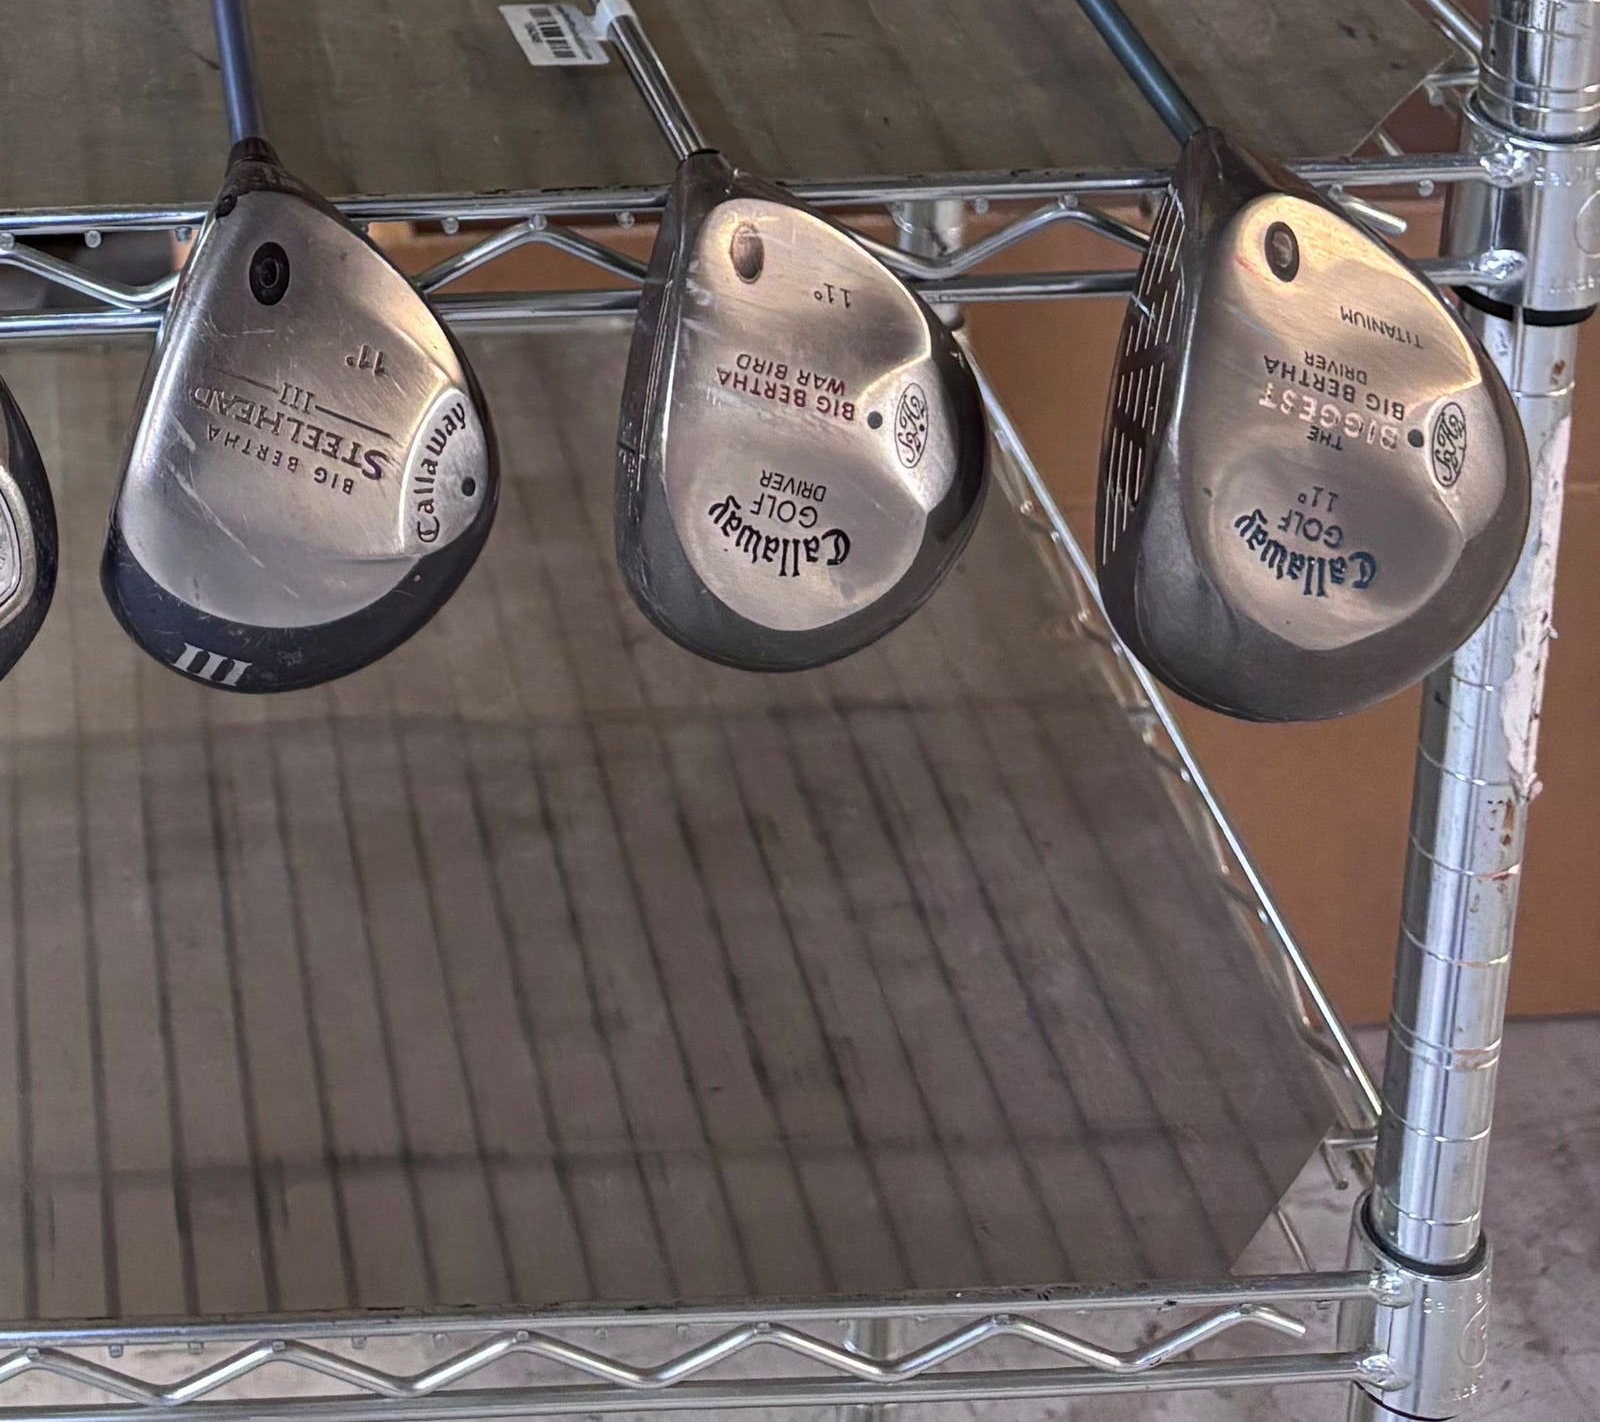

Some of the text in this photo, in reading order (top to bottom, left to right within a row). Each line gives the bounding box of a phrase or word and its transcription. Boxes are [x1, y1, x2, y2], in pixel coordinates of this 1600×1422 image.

[1340, 304, 1425, 350] TITANIUM
[736, 352, 847, 395] WAR BIRD
[1263, 354, 1406, 421] BIG BERTHA
[1302, 350, 1369, 386] DRIVER
[715, 366, 856, 422] BIG BERTHA
[1257, 381, 1399, 451] BIGGEST
[192, 382, 391, 482] STEELHEAD
[1306, 428, 1345, 452] THE
[205, 423, 356, 496] BIG BERTHA
[415, 401, 467, 544] Callaway
[758, 468, 828, 502] DRIVER
[706, 494, 853, 578] Callaway
[749, 495, 819, 529] GOLF
[1277, 507, 1345, 547] GOLF
[1233, 504, 1377, 599] Callaway
[170, 642, 255, 687] III
